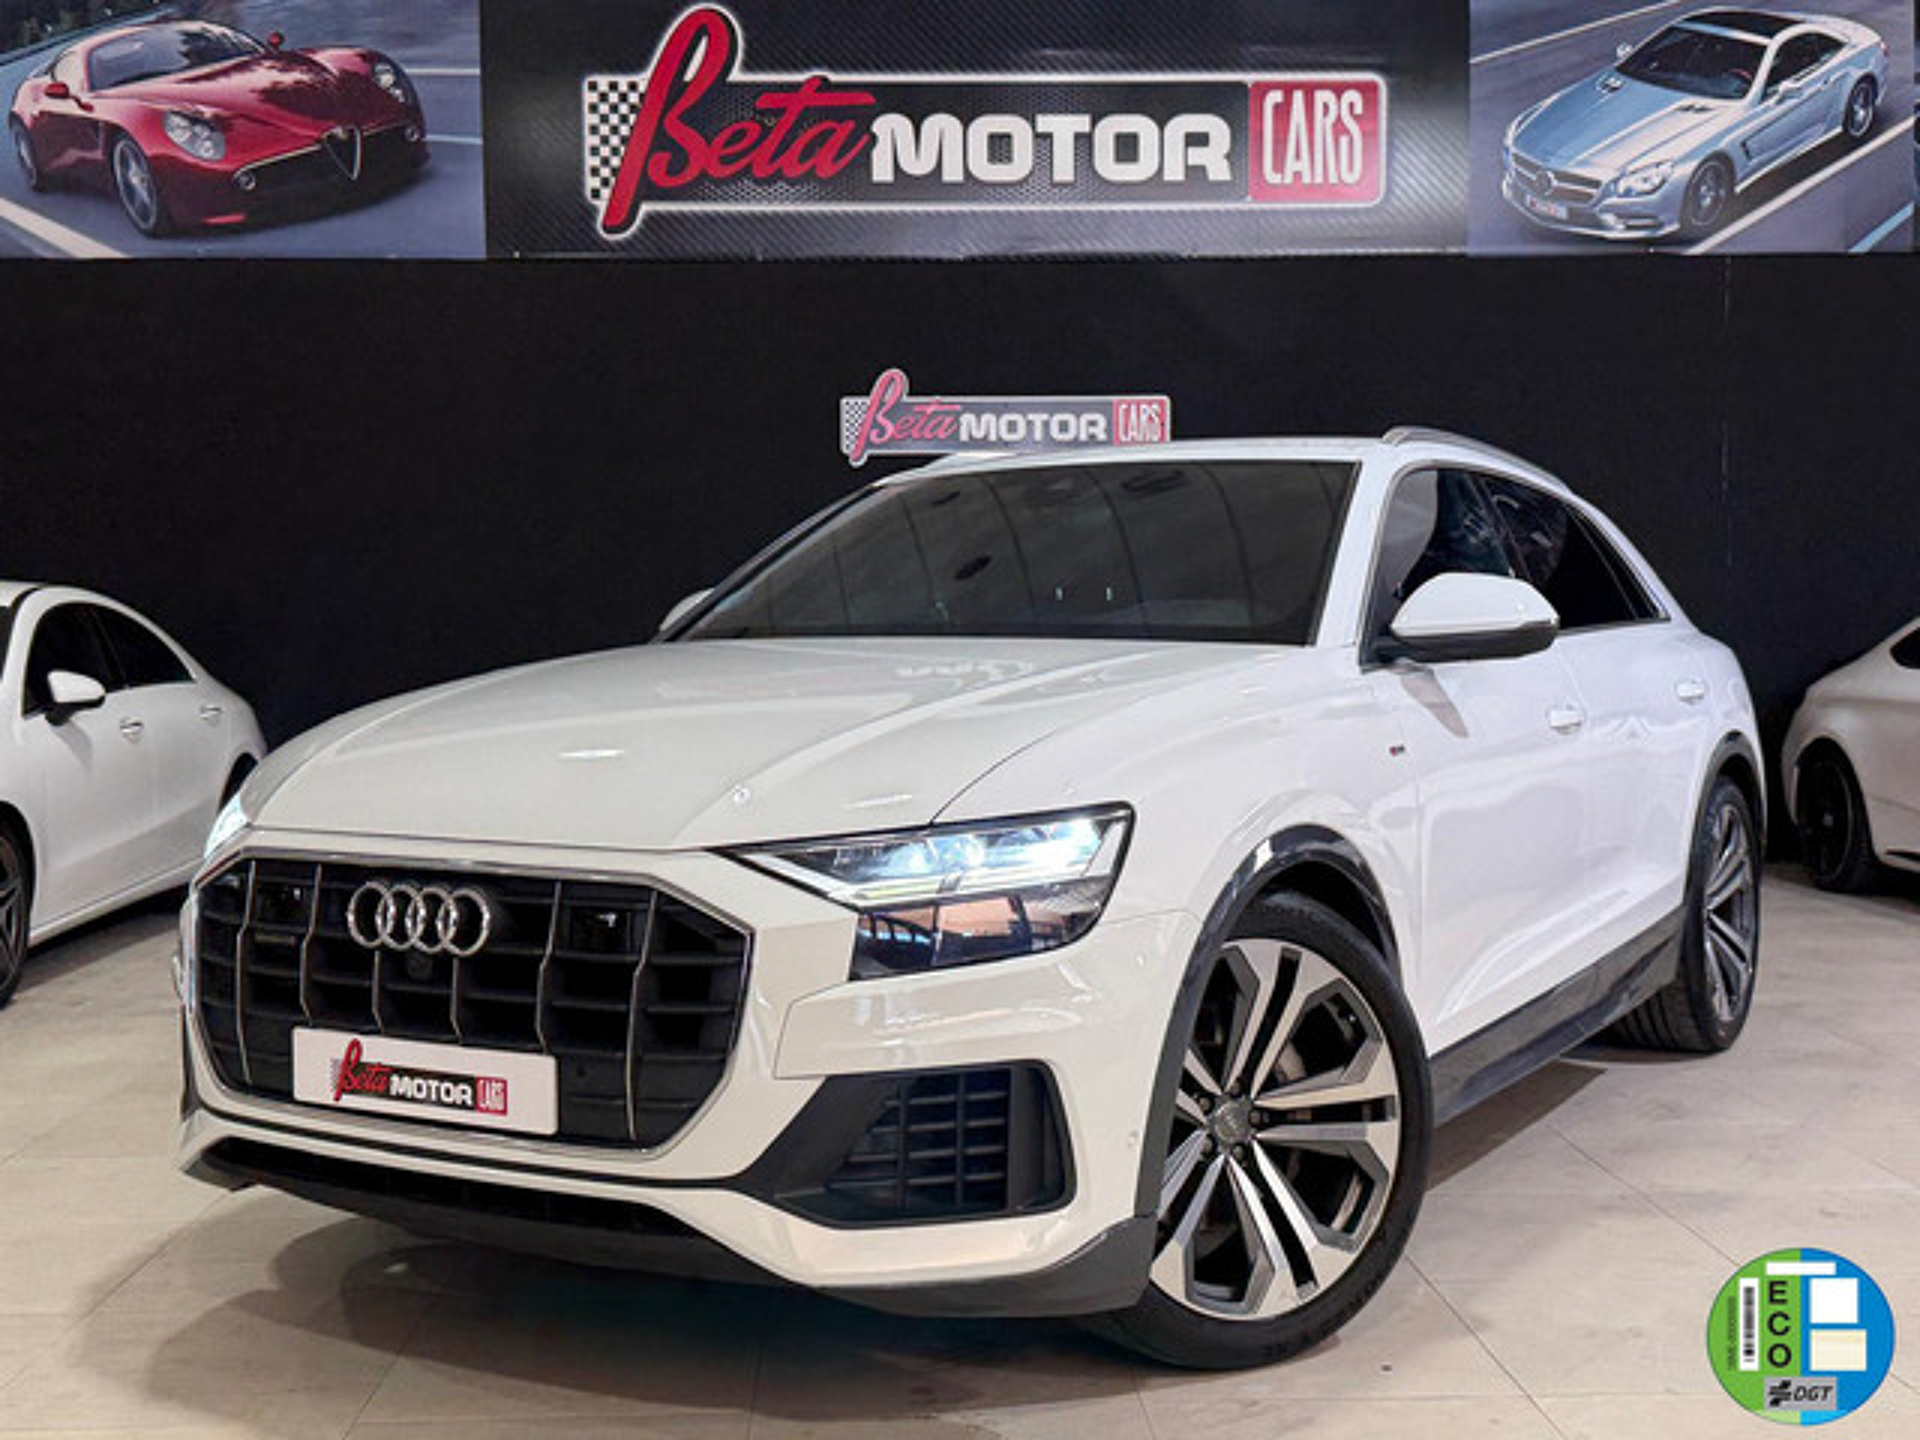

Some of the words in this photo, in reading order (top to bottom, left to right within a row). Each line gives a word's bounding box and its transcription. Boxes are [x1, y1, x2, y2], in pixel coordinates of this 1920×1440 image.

[602, 9, 876, 228] Beta
[871, 112, 1232, 184] MOTOR
[1261, 89, 1364, 187] CARS
[851, 371, 961, 462] Beta
[959, 412, 1108, 442] MOTOR
[1118, 403, 1161, 442] CARS
[390, 1074, 473, 1106] MOTOR
